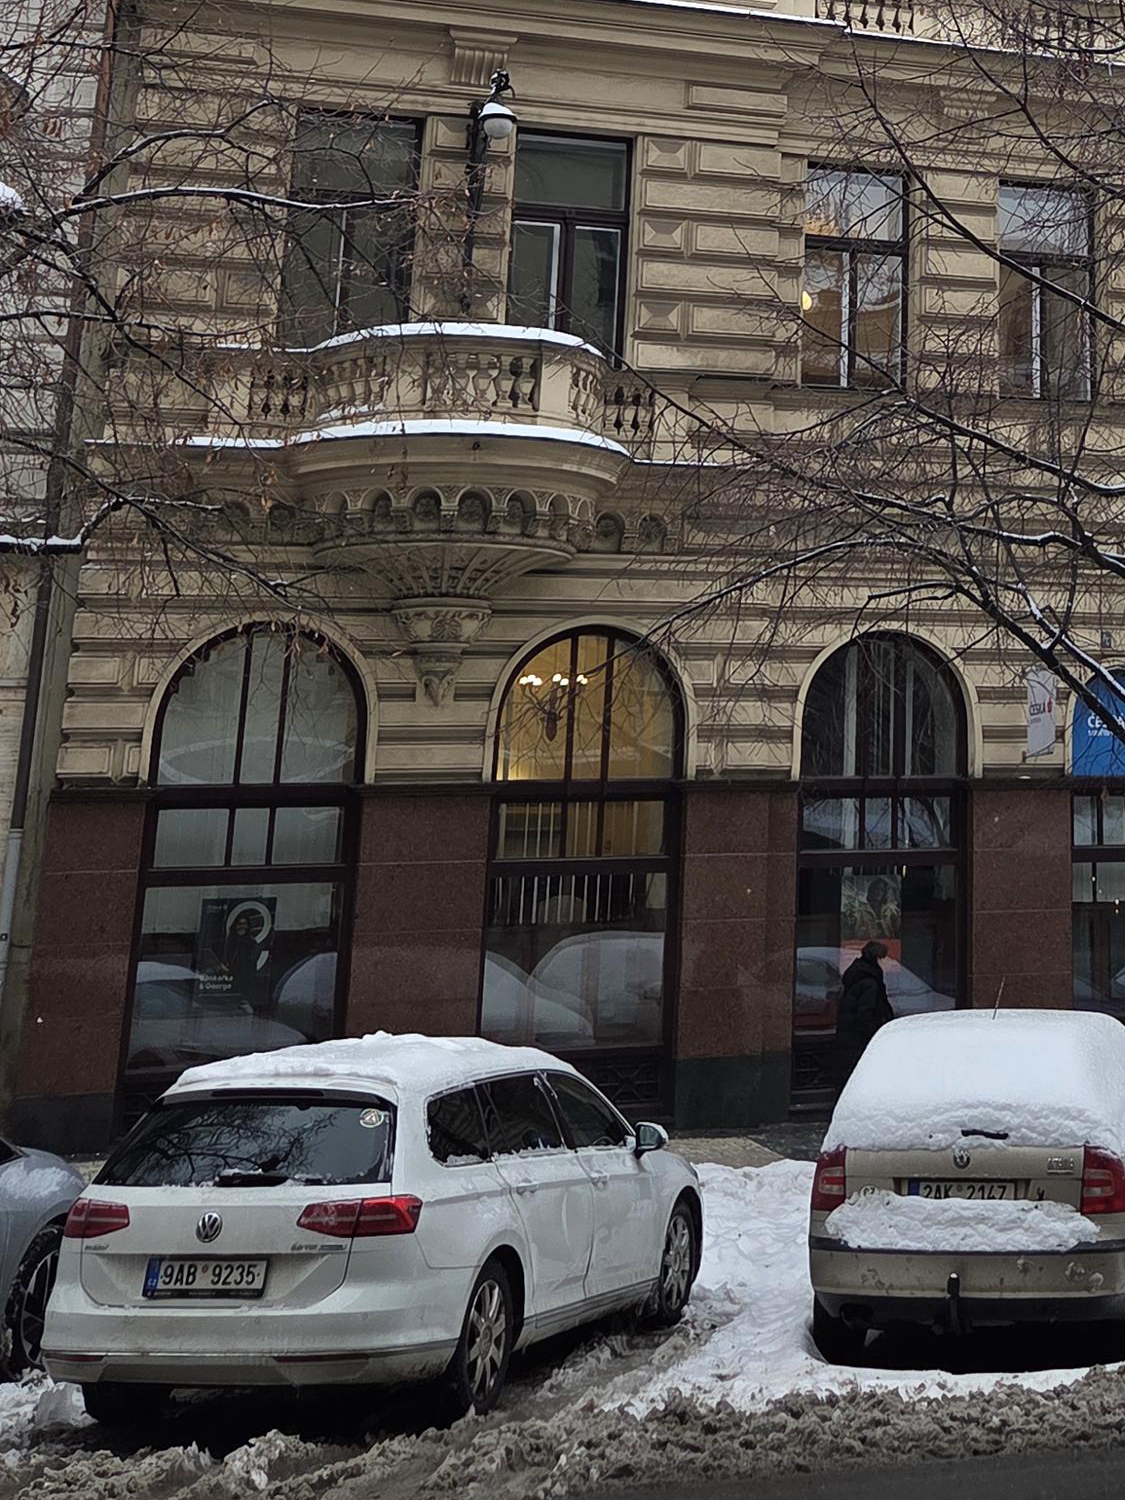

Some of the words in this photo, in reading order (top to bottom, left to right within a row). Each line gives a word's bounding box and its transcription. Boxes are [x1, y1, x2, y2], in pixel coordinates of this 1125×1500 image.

[923, 1184, 953, 1200] 2AK
[967, 1184, 1007, 1200] 2147
[161, 1263, 198, 1286] 9AB
[210, 1263, 258, 1286] 9235
